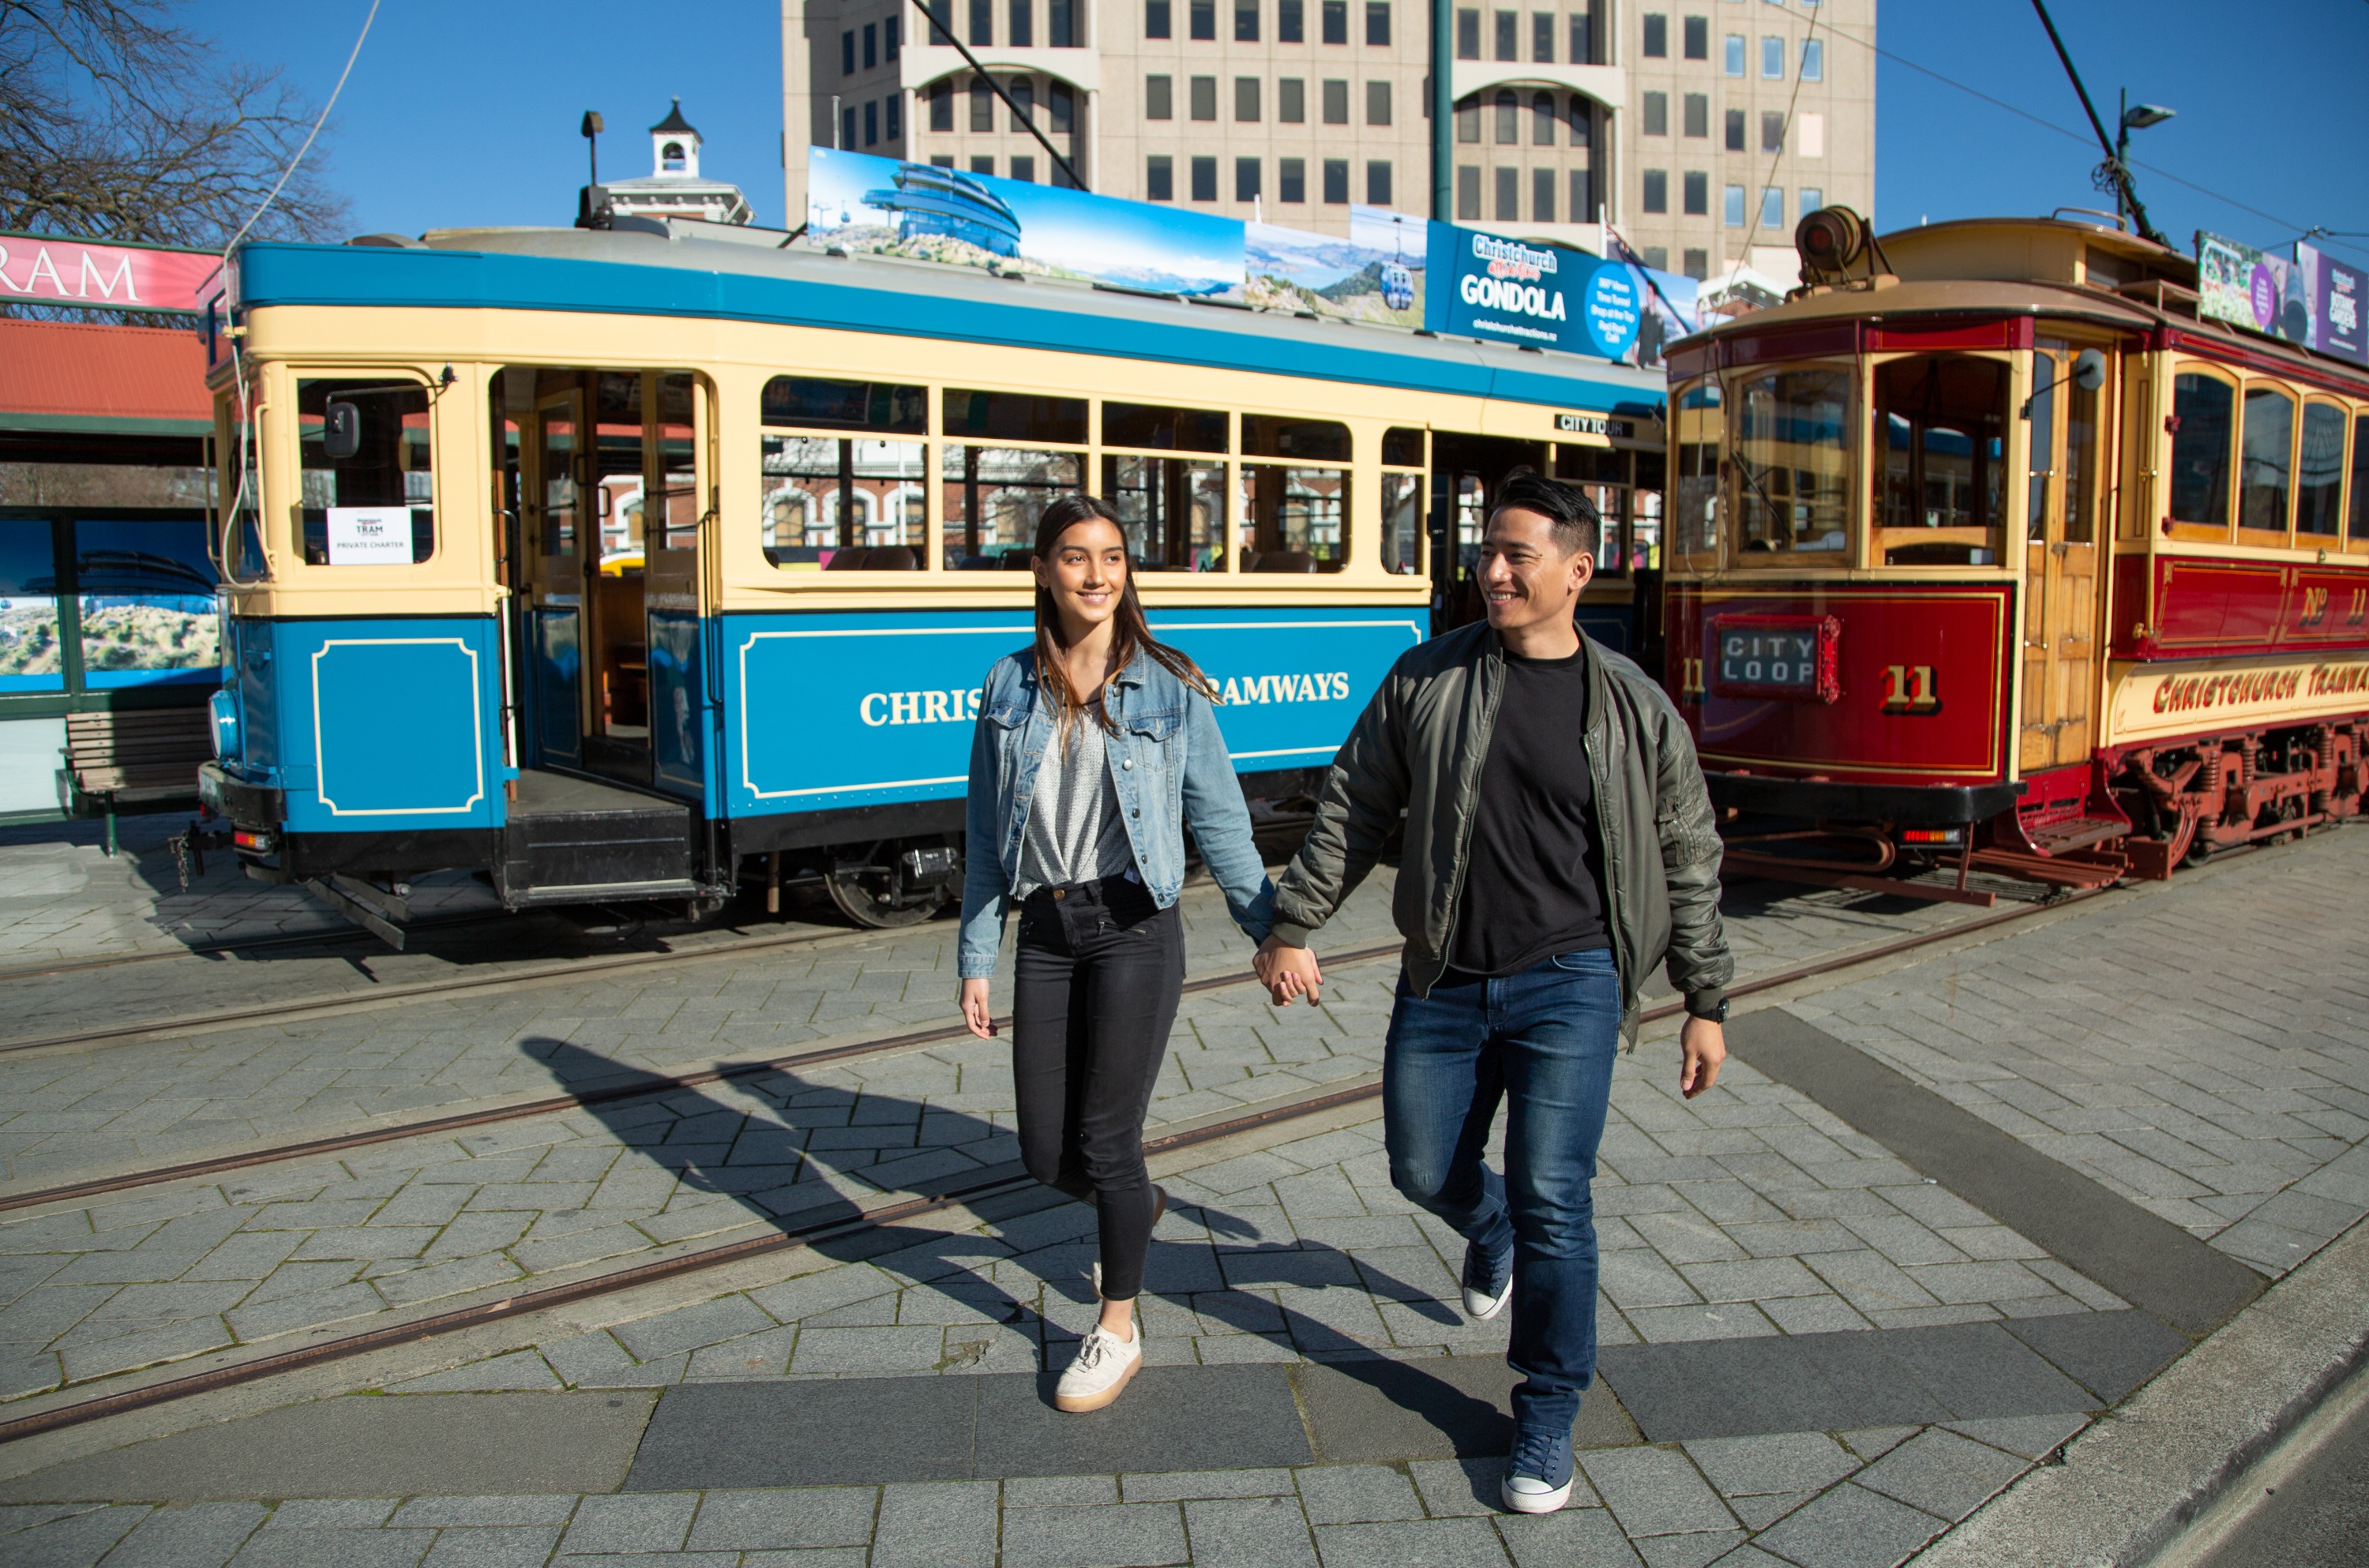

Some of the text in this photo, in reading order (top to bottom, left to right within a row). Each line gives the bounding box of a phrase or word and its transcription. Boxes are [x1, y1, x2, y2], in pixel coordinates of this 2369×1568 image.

[1473, 234, 1557, 274] Christchurch
[1487, 260, 1541, 282] attractions
[1461, 274, 1566, 321] GONDOLA
[1473, 319, 1557, 342] christchurchattractions.nz
[1560, 415, 1624, 436] CITY TOUR
[1726, 636, 1814, 658] CITY
[1683, 657, 1706, 696] 11
[1724, 659, 1814, 684] LOOP
[1880, 664, 1939, 710] 11
